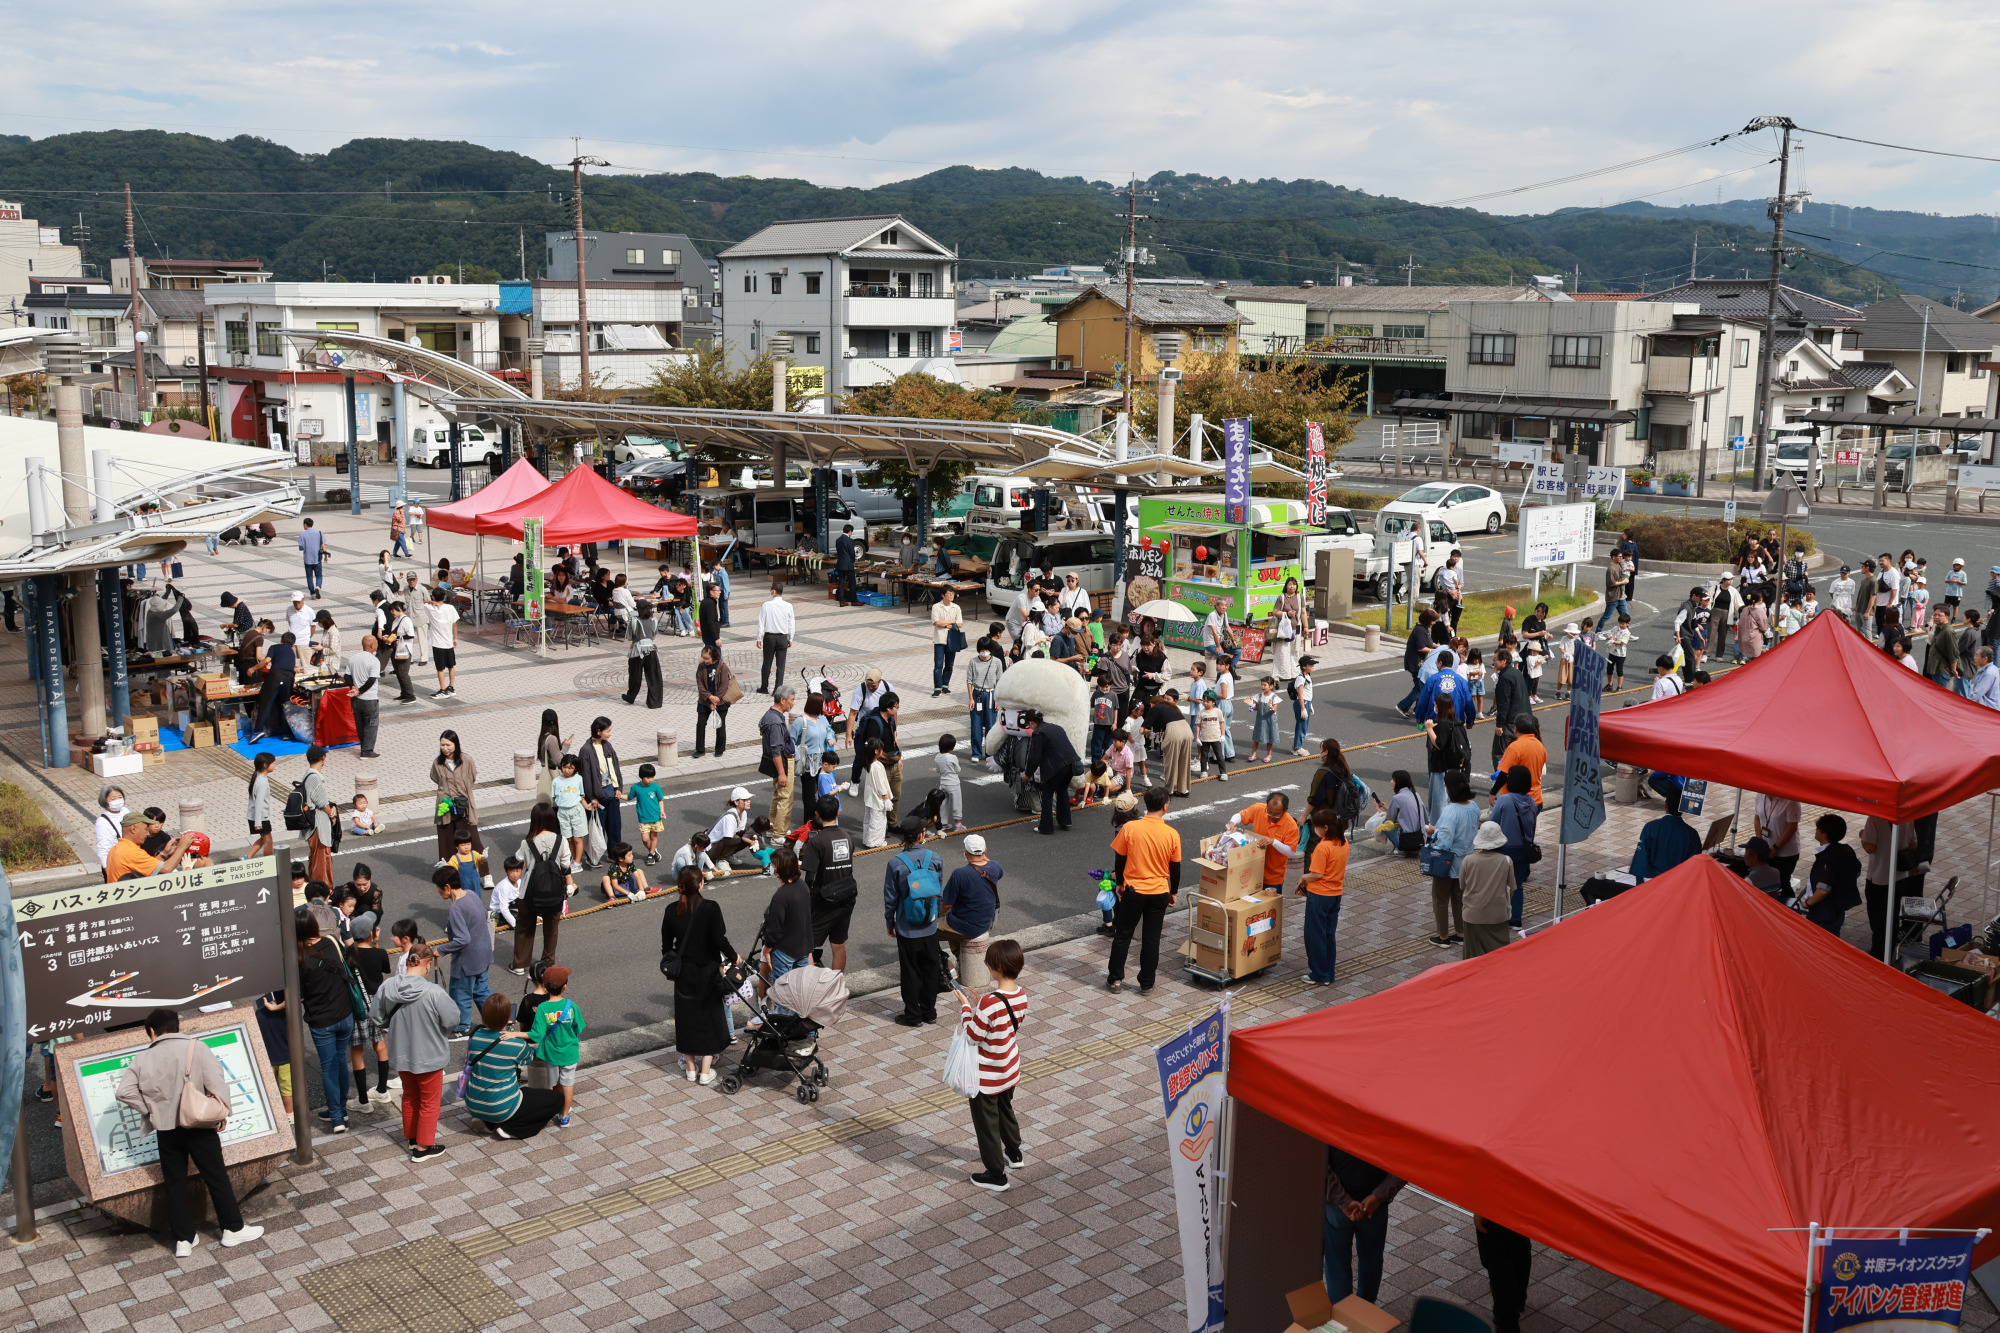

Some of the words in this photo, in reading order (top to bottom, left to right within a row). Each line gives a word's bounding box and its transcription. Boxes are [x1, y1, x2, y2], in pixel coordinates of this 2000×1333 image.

[1537, 465, 1619, 482] 駅ビナント
[1536, 480, 1618, 496] お客様用駐車場
[1166, 504, 1225, 521] せんたの焼き
[1128, 547, 1163, 563] ホルモン
[1140, 563, 1163, 578] うどん
[111, 592, 120, 629] IBARA
[45, 605, 56, 644] IBARA
[114, 632, 123, 669] DENIM
[49, 647, 60, 687] DENIM
[230, 865, 244, 873] BUS
[246, 861, 264, 870] STOP
[230, 873, 246, 881] TAXI
[246, 869, 265, 878] STOP
[52, 872, 204, 910] バス・タクシーのりば
[180, 909, 188, 922] 1
[44, 934, 55, 947] 4
[86, 935, 160, 957] 井原あいあいバス
[182, 933, 192, 946] 2
[47, 958, 58, 972] 3
[49, 1009, 112, 1033] タクシーのりば
[1864, 1253, 1968, 1274] 井原ライオンズクラブ
[1828, 1280, 1965, 1317] アイバンク登録推進
